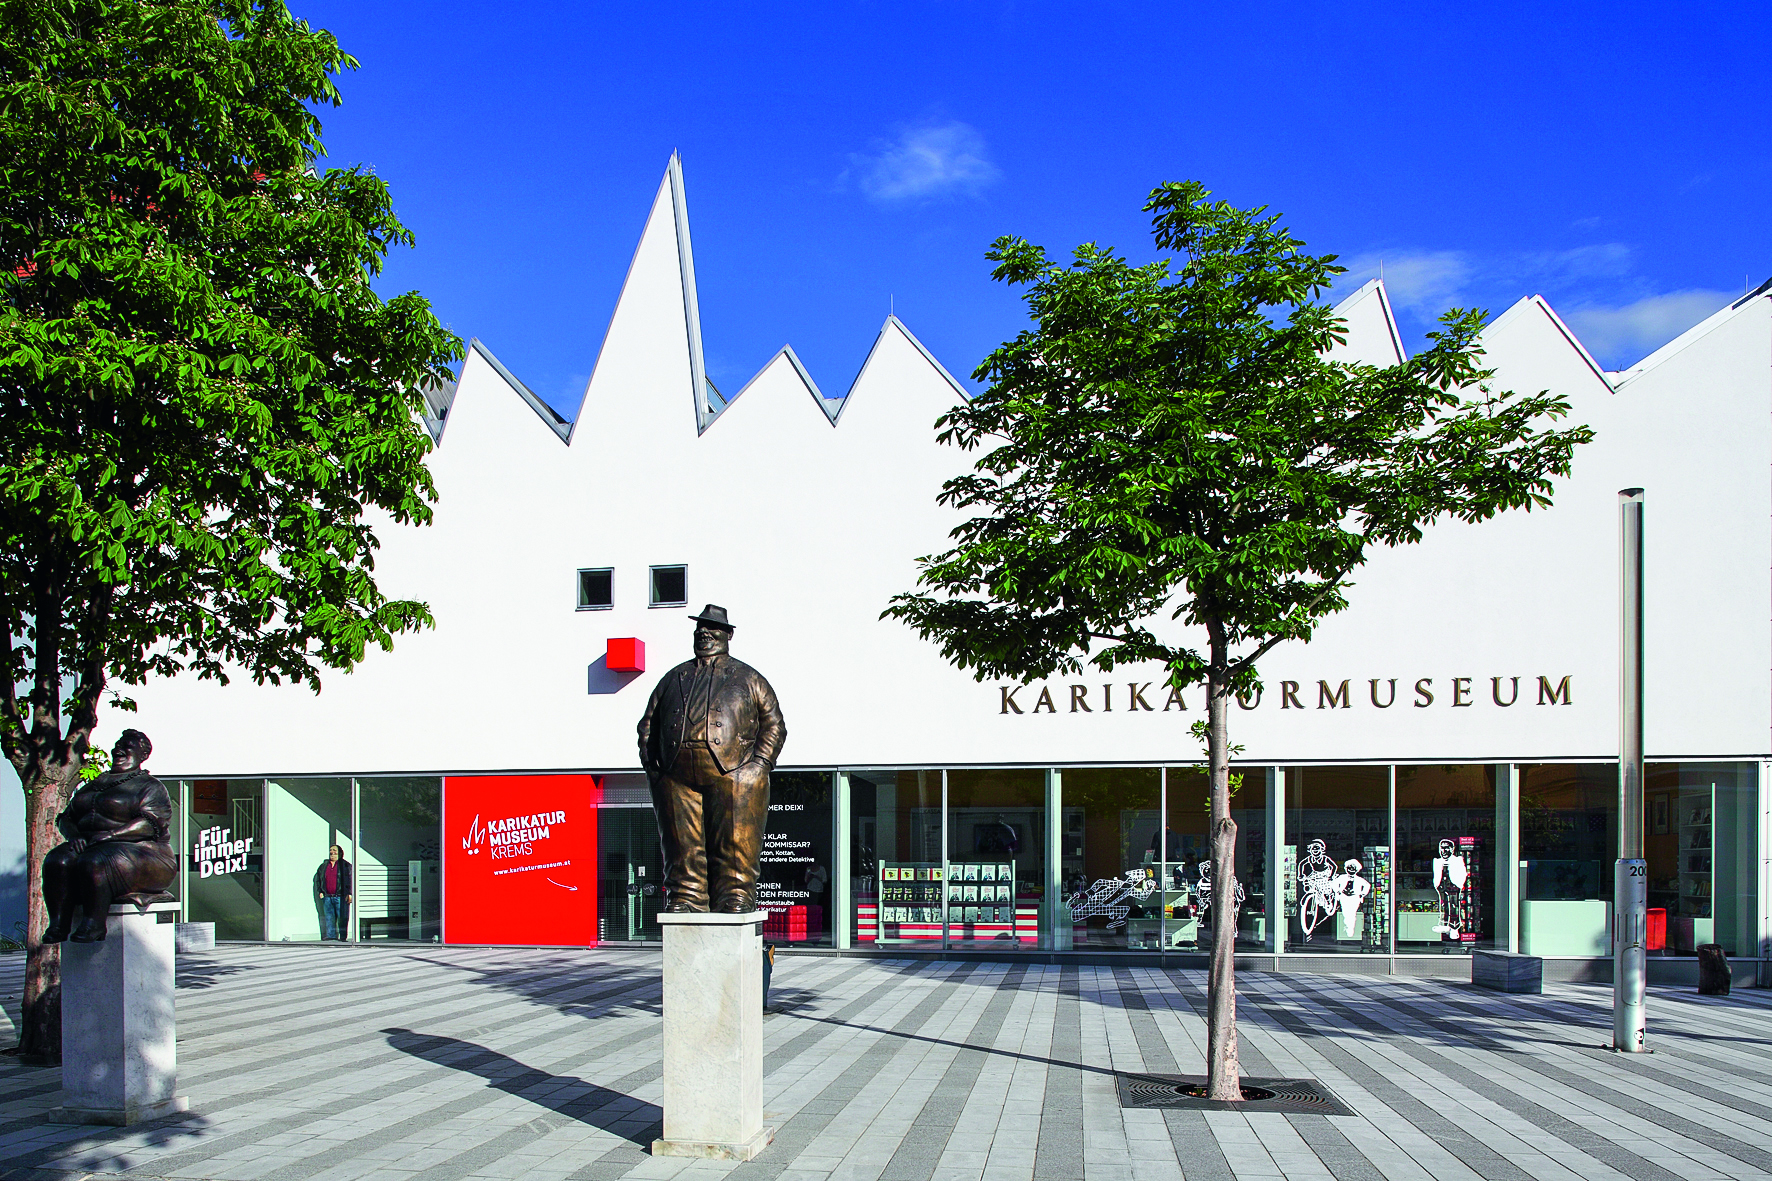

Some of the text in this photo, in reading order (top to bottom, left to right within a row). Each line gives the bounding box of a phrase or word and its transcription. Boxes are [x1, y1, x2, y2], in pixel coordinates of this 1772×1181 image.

[998, 674, 1573, 714] KARIKATURMUSEUM
[487, 810, 566, 834] KARIKATUR
[200, 825, 231, 848] Für
[489, 826, 550, 847] MUSEUM
[194, 837, 254, 863] immer
[490, 842, 533, 860] KREMS
[200, 852, 248, 879] Deix!
[493, 859, 571, 876] www.karikaturmuseum.at
